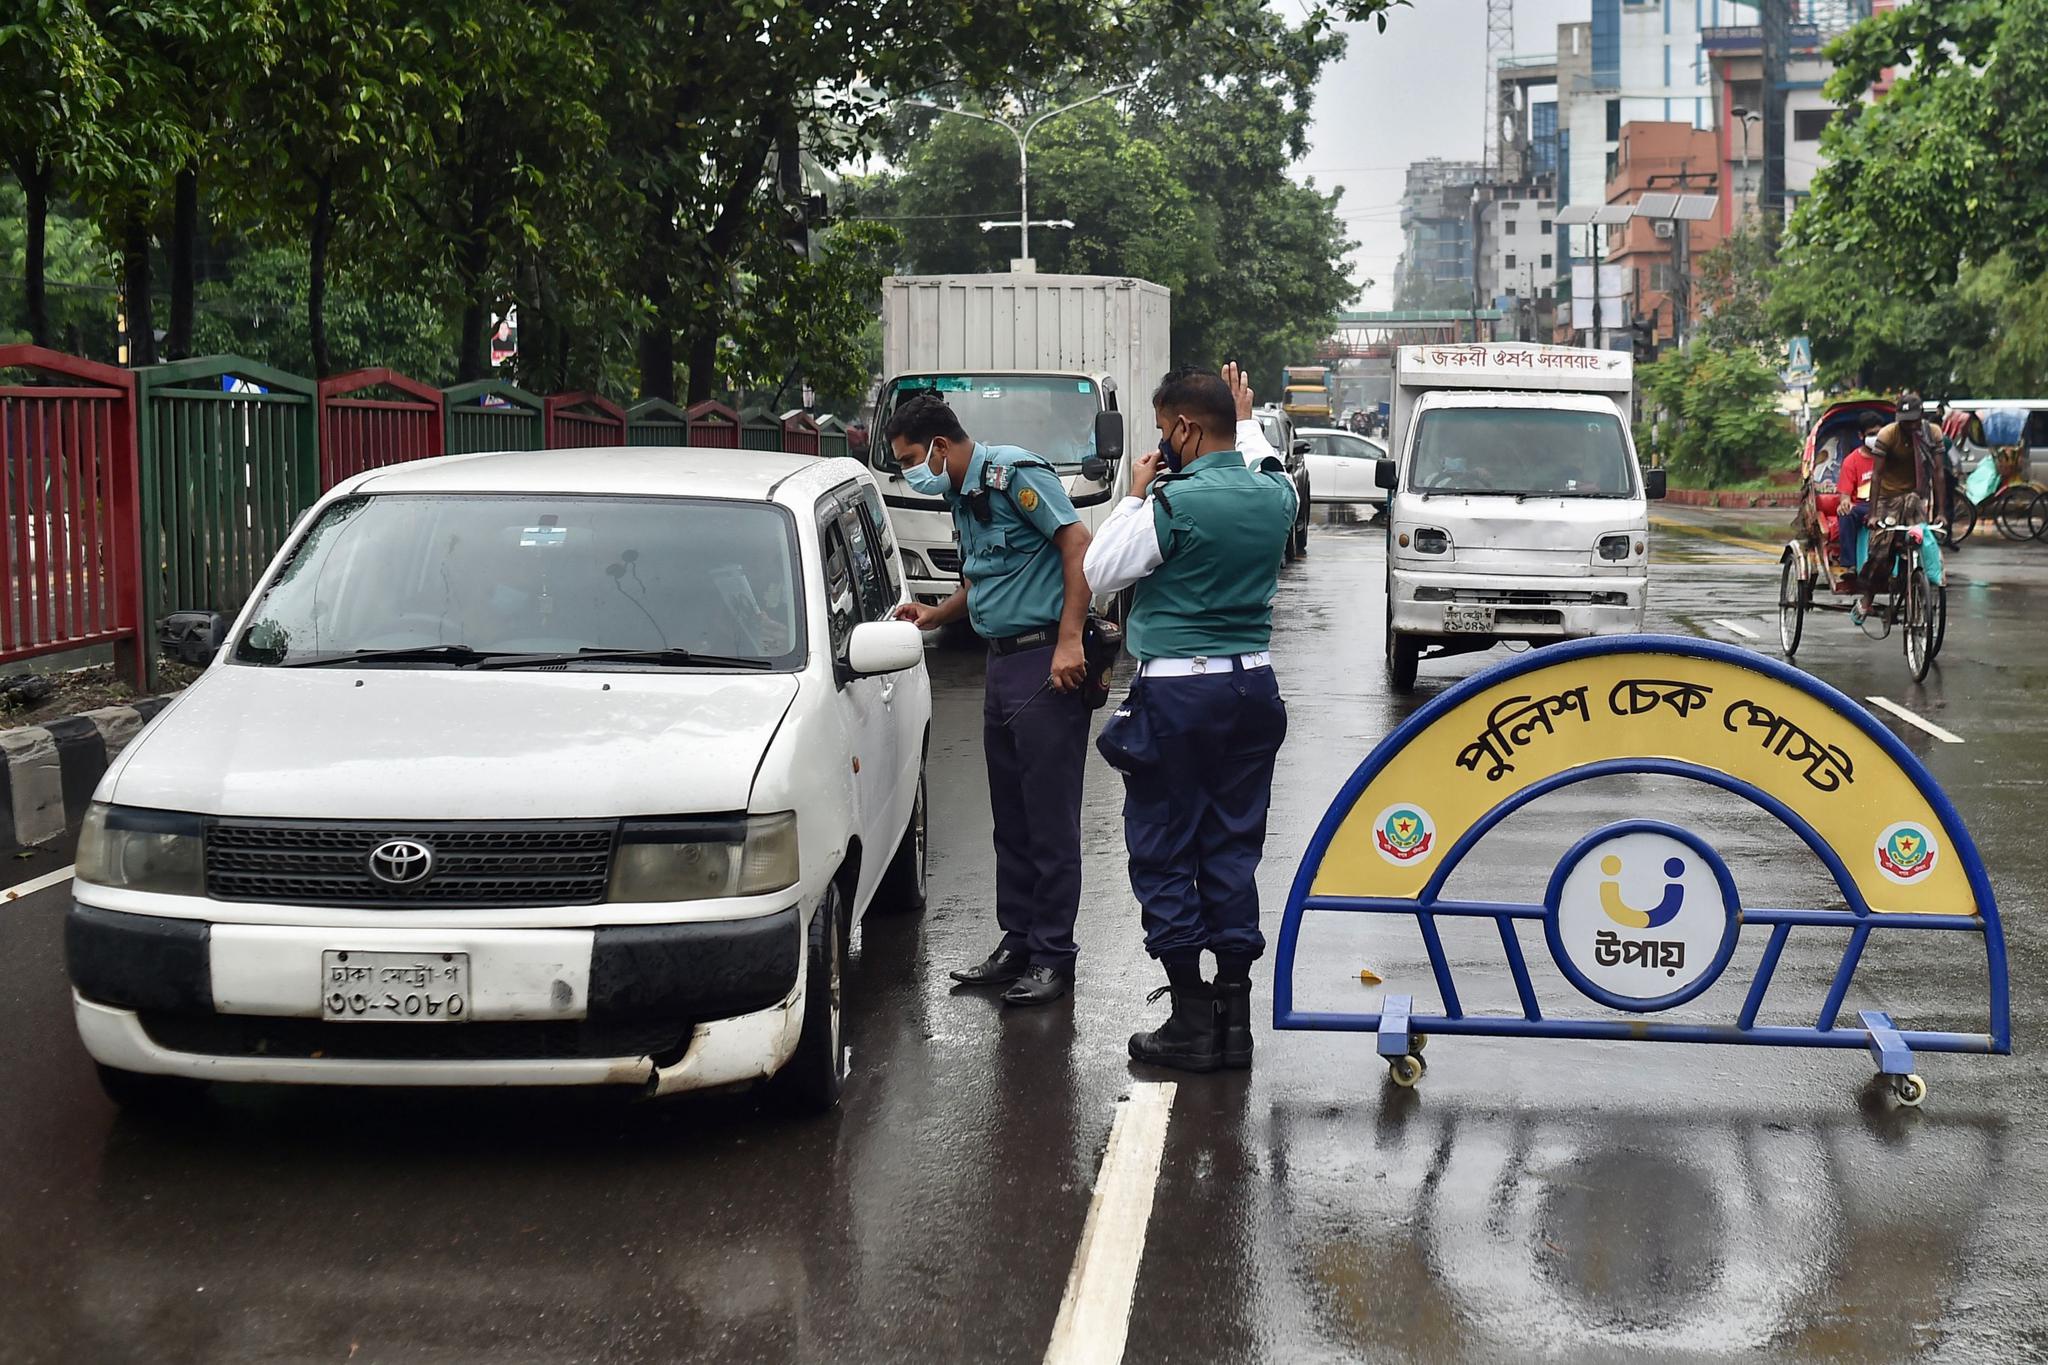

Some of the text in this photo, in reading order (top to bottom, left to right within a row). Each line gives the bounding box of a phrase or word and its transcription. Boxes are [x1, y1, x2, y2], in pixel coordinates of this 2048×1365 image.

[1431, 346, 1600, 370] জরুরী ঔষধ সরবরাহ
[1455, 679, 1856, 793] পুলিশ চেক পোস্ট
[1594, 930, 1686, 978] উপায়
[330, 964, 374, 984] ঢাকা
[326, 993, 464, 1016] ৩৩-২০৮০
